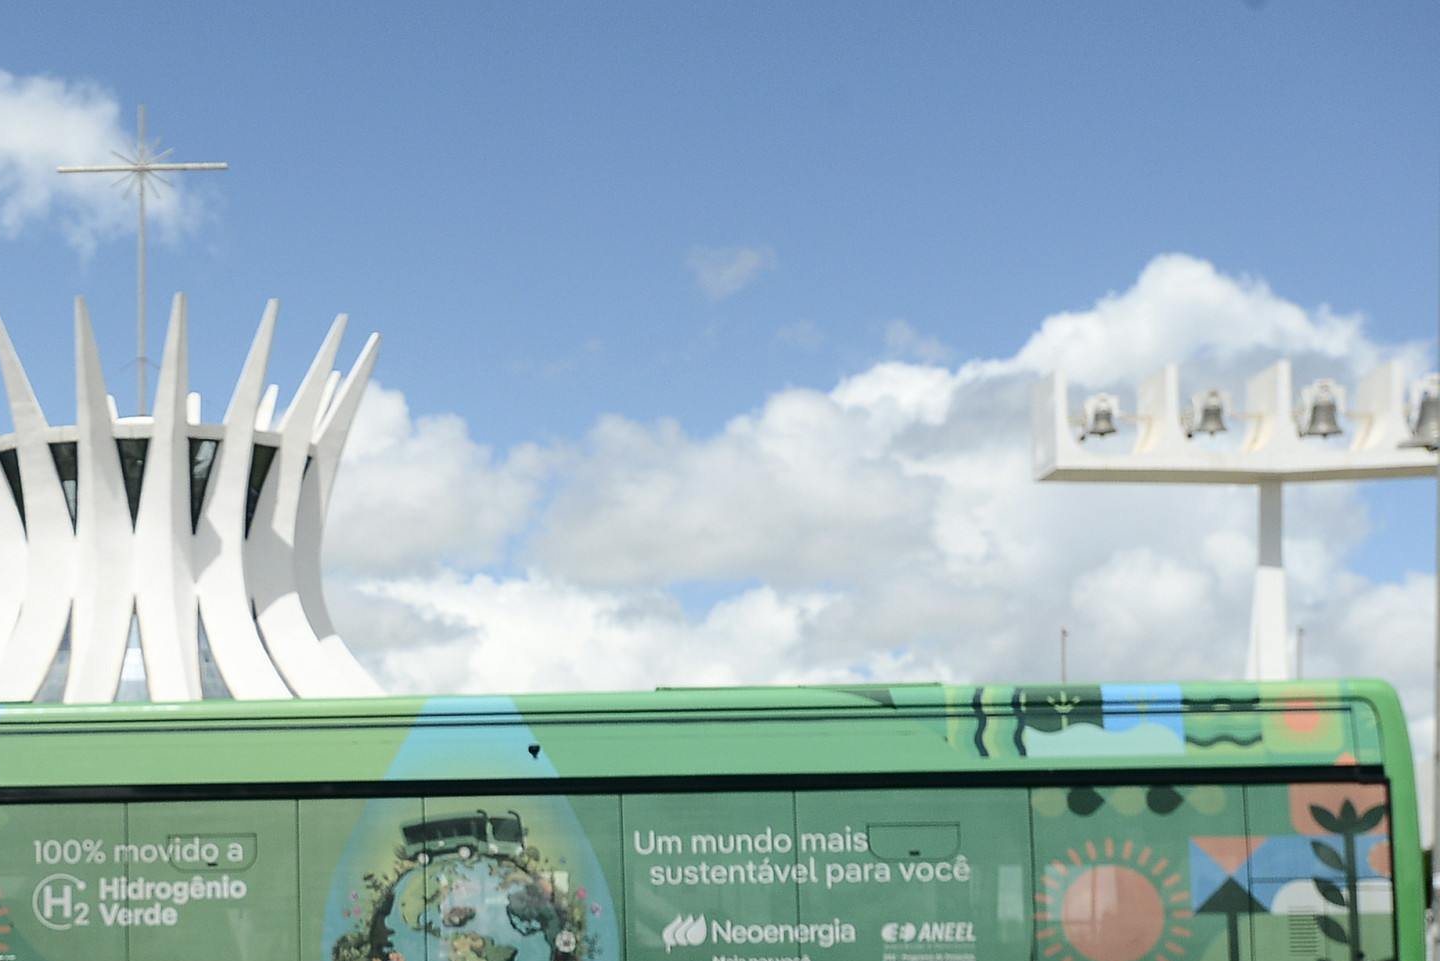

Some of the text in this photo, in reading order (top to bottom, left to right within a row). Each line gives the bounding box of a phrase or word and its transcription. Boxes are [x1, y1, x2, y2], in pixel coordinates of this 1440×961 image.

[33, 837, 244, 864] 100% movido a
[634, 826, 868, 854] Um mundo mais
[650, 854, 971, 889] sustentável para você
[98, 874, 247, 904] Hidrogênio
[98, 903, 178, 926] Verde
[712, 917, 856, 948] Neoenergia
[917, 921, 977, 942] ANEEL
